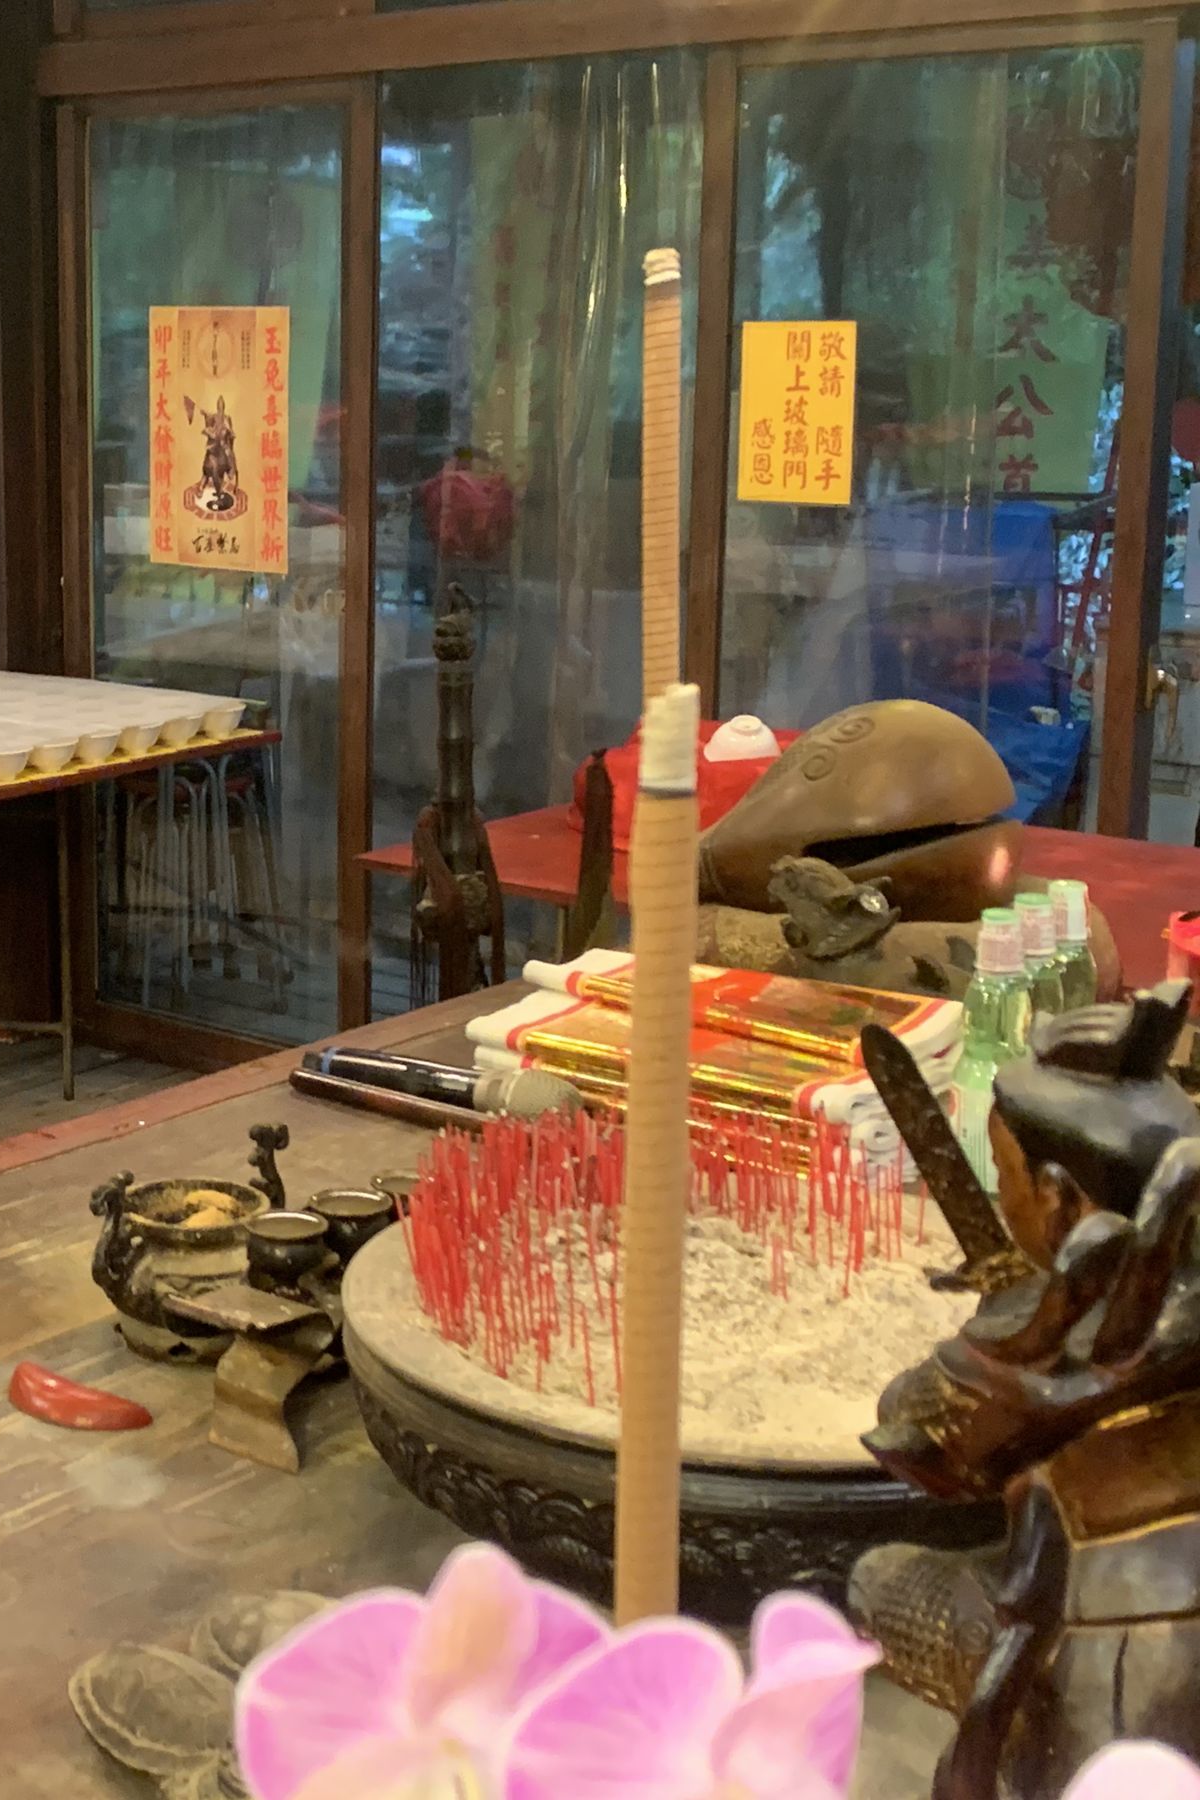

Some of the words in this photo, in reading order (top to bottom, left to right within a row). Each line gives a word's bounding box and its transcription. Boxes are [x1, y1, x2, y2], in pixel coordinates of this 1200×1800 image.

[783, 329, 812, 490] 關上玻璃門
[818, 331, 847, 398] 敬請
[153, 325, 174, 553] 卯年大發財源旺
[259, 326, 284, 563] 玉兔喜臨世界新
[750, 417, 776, 485] 感恩
[814, 424, 843, 491] 隨手
